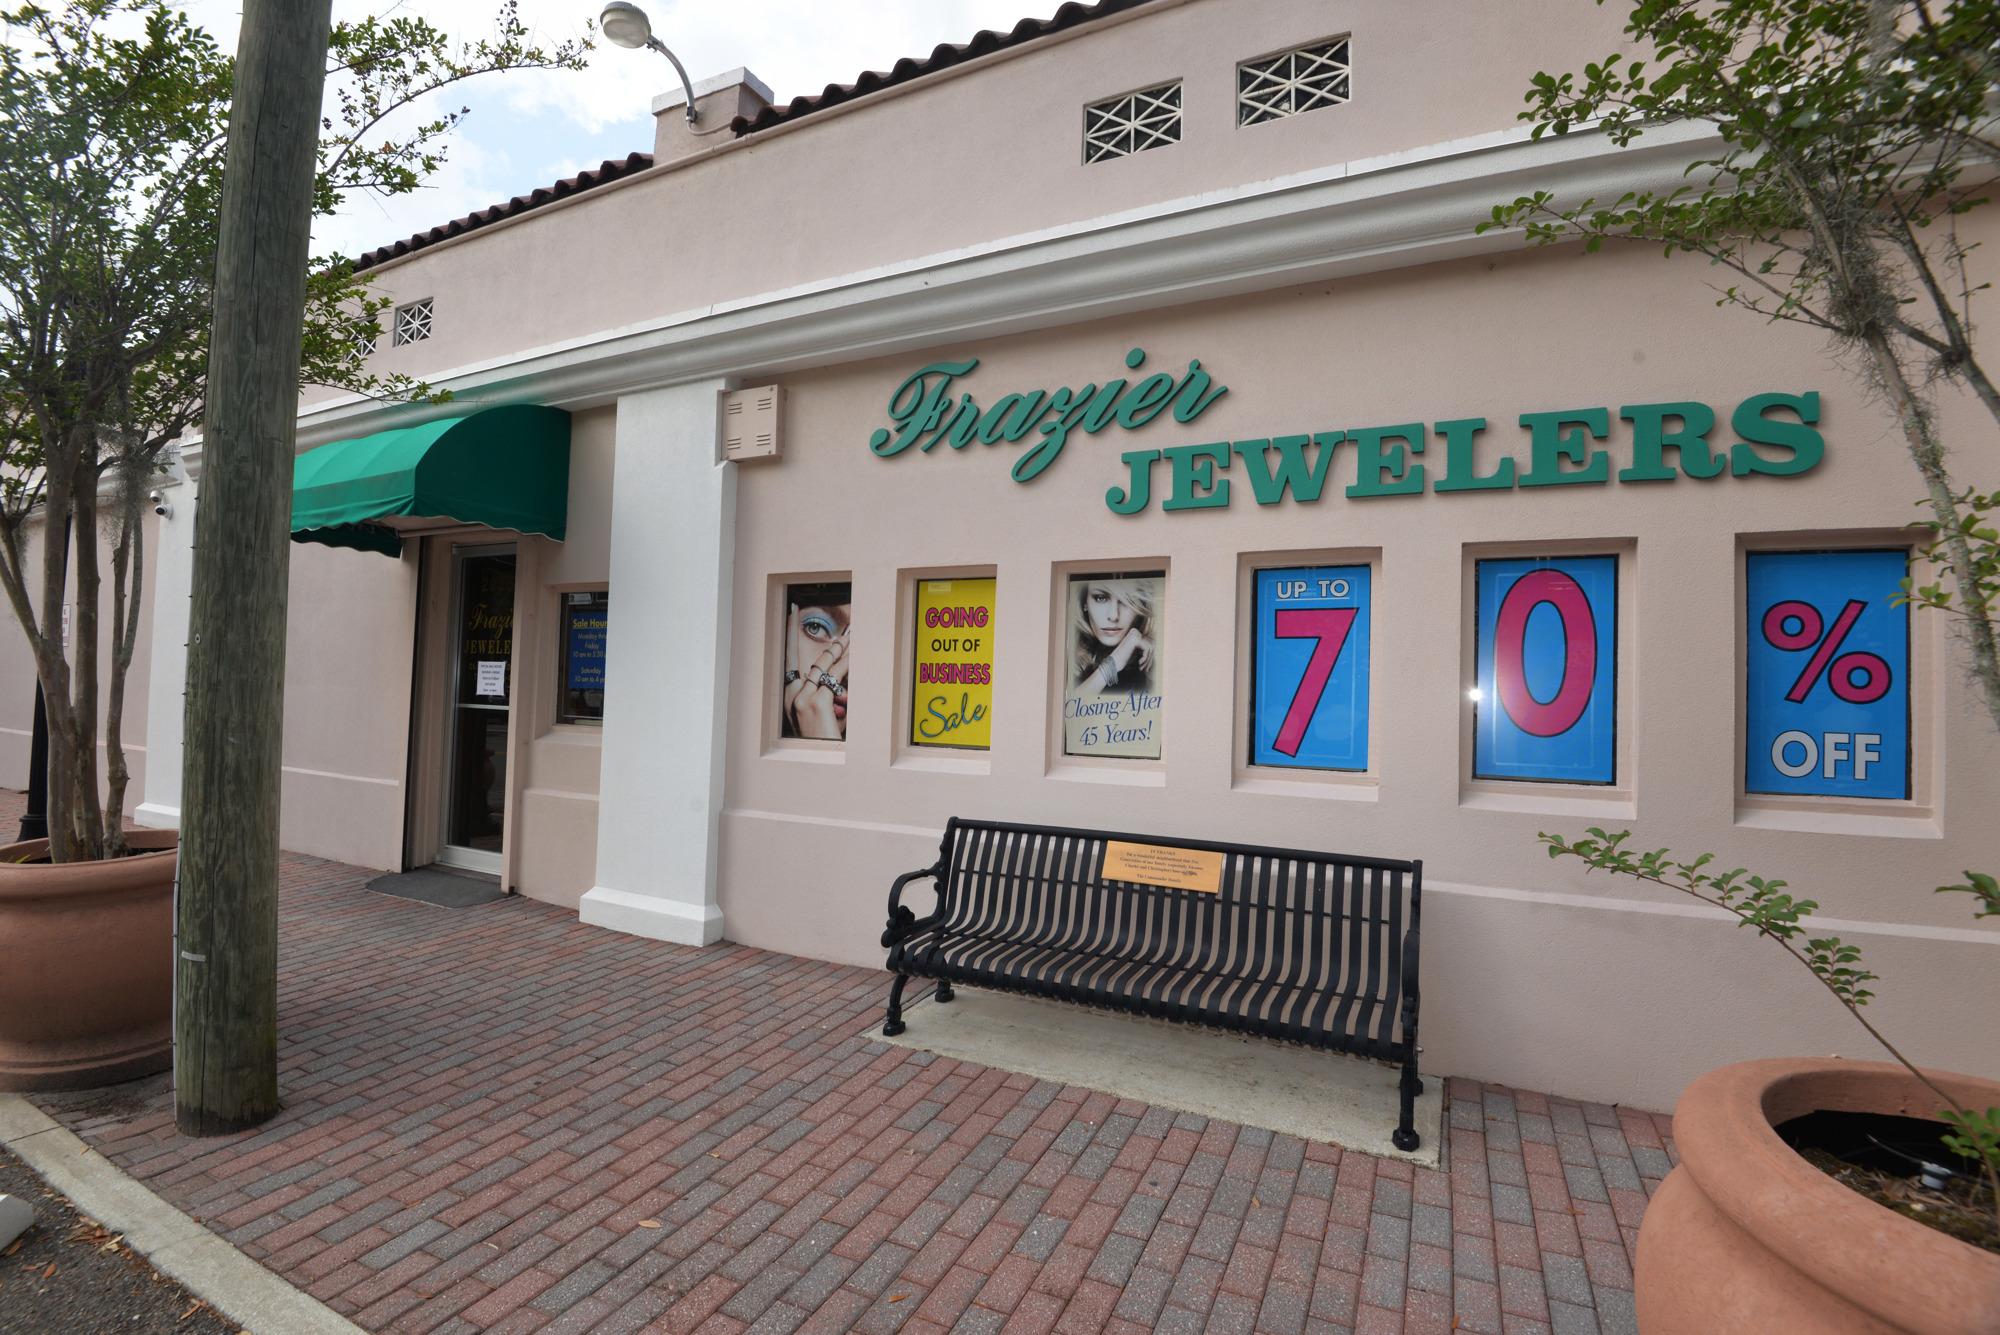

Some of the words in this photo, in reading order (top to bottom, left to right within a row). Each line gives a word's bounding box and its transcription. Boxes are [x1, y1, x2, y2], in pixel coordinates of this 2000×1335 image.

[869, 347, 1228, 483] Frazier
[1105, 390, 1825, 515] JEWELERS
[1277, 580, 1308, 599] UP
[1317, 579, 1350, 597] TO
[573, 618, 588, 628] Sale
[925, 606, 989, 628] GOING
[578, 632, 597, 640] Monday
[584, 642, 599, 651] Friday
[931, 639, 959, 652] OUT
[962, 639, 981, 652] OF
[1494, 567, 1598, 738] 0
[1761, 598, 1893, 705] %
[580, 666, 601, 675] Saturday
[919, 662, 991, 685] BUSINESS
[1271, 606, 1361, 758] 7
[919, 692, 988, 738] Sale
[1065, 697, 1122, 721] Closing
[1121, 687, 1162, 717] After
[1079, 725, 1099, 746] 45
[1104, 719, 1153, 744] Years!
[1770, 729, 1882, 780] OFF
